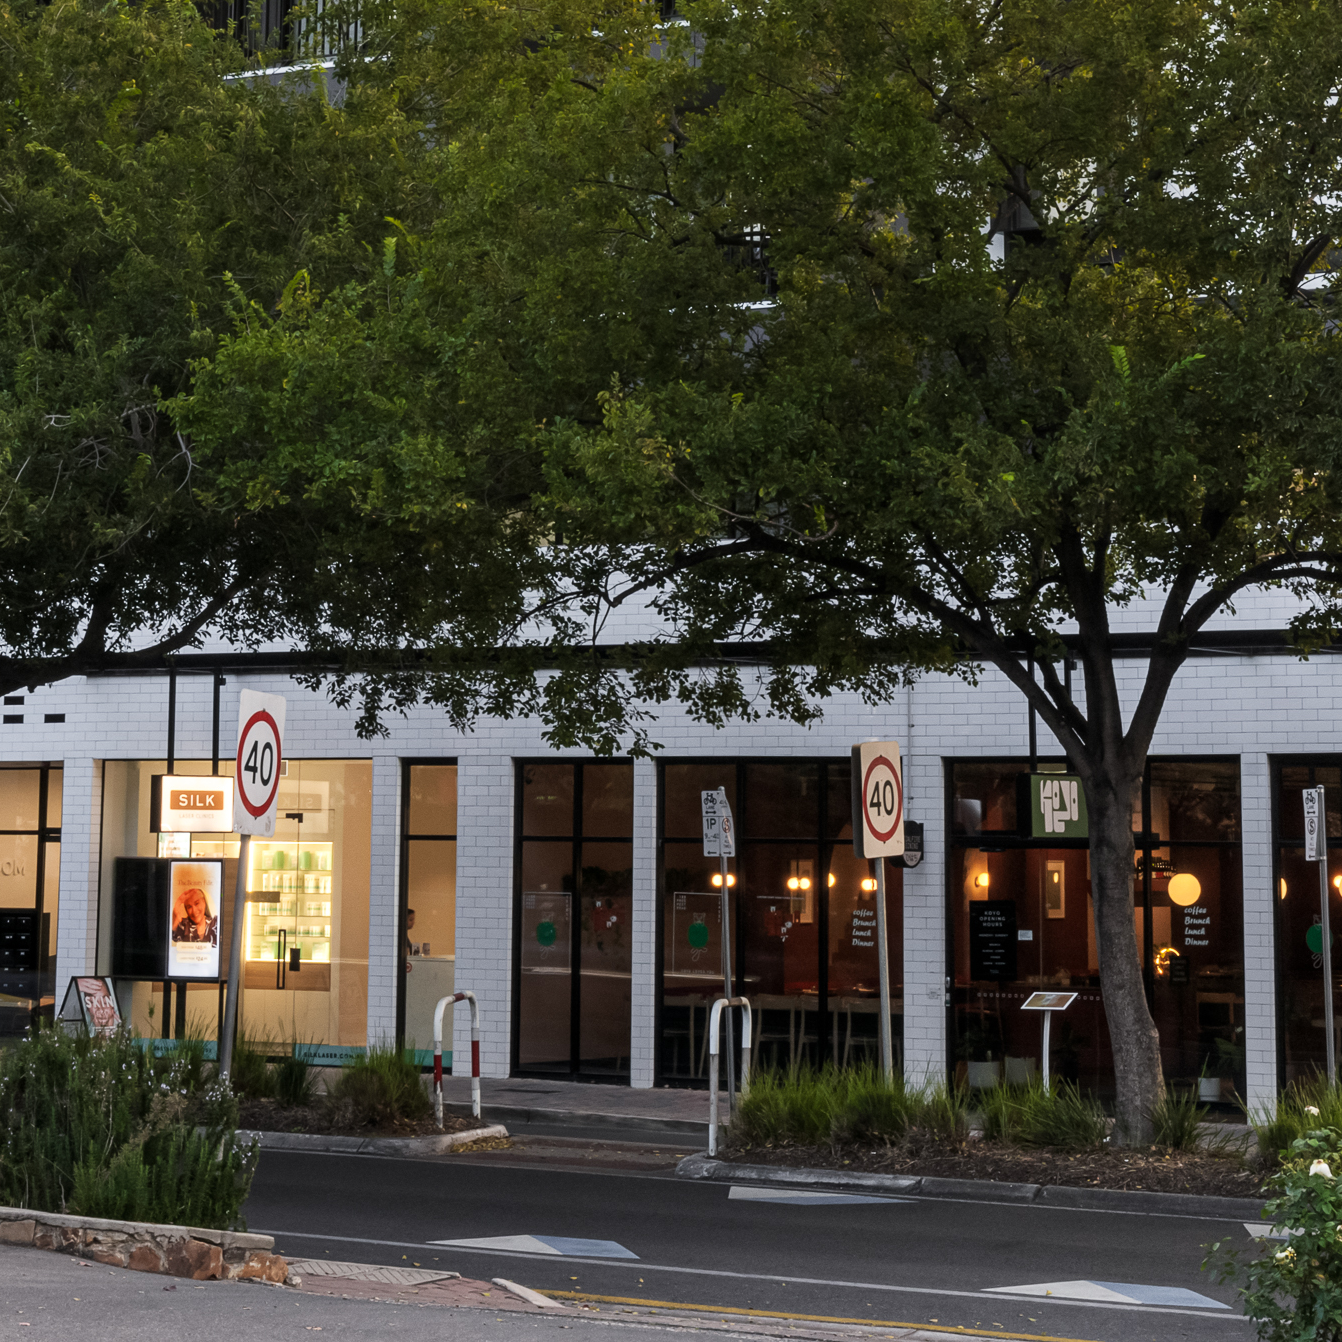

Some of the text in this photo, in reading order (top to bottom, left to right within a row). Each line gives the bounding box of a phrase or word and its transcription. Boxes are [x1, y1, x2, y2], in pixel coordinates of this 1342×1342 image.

[244, 740, 274, 787] 40
[178, 794, 215, 807] SILK
[869, 780, 894, 816] 40
[706, 818, 717, 829] 1P
[852, 909, 874, 917] coffee
[1184, 906, 1207, 915] coffee
[852, 918, 876, 926] Brunch
[1184, 917, 1210, 925] Brunch
[852, 928, 871, 936] Lunch
[1184, 927, 1206, 935] Lunch
[852, 938, 874, 947] Dinner
[1184, 938, 1209, 946] Dinner
[85, 996, 114, 1008] SKIN
